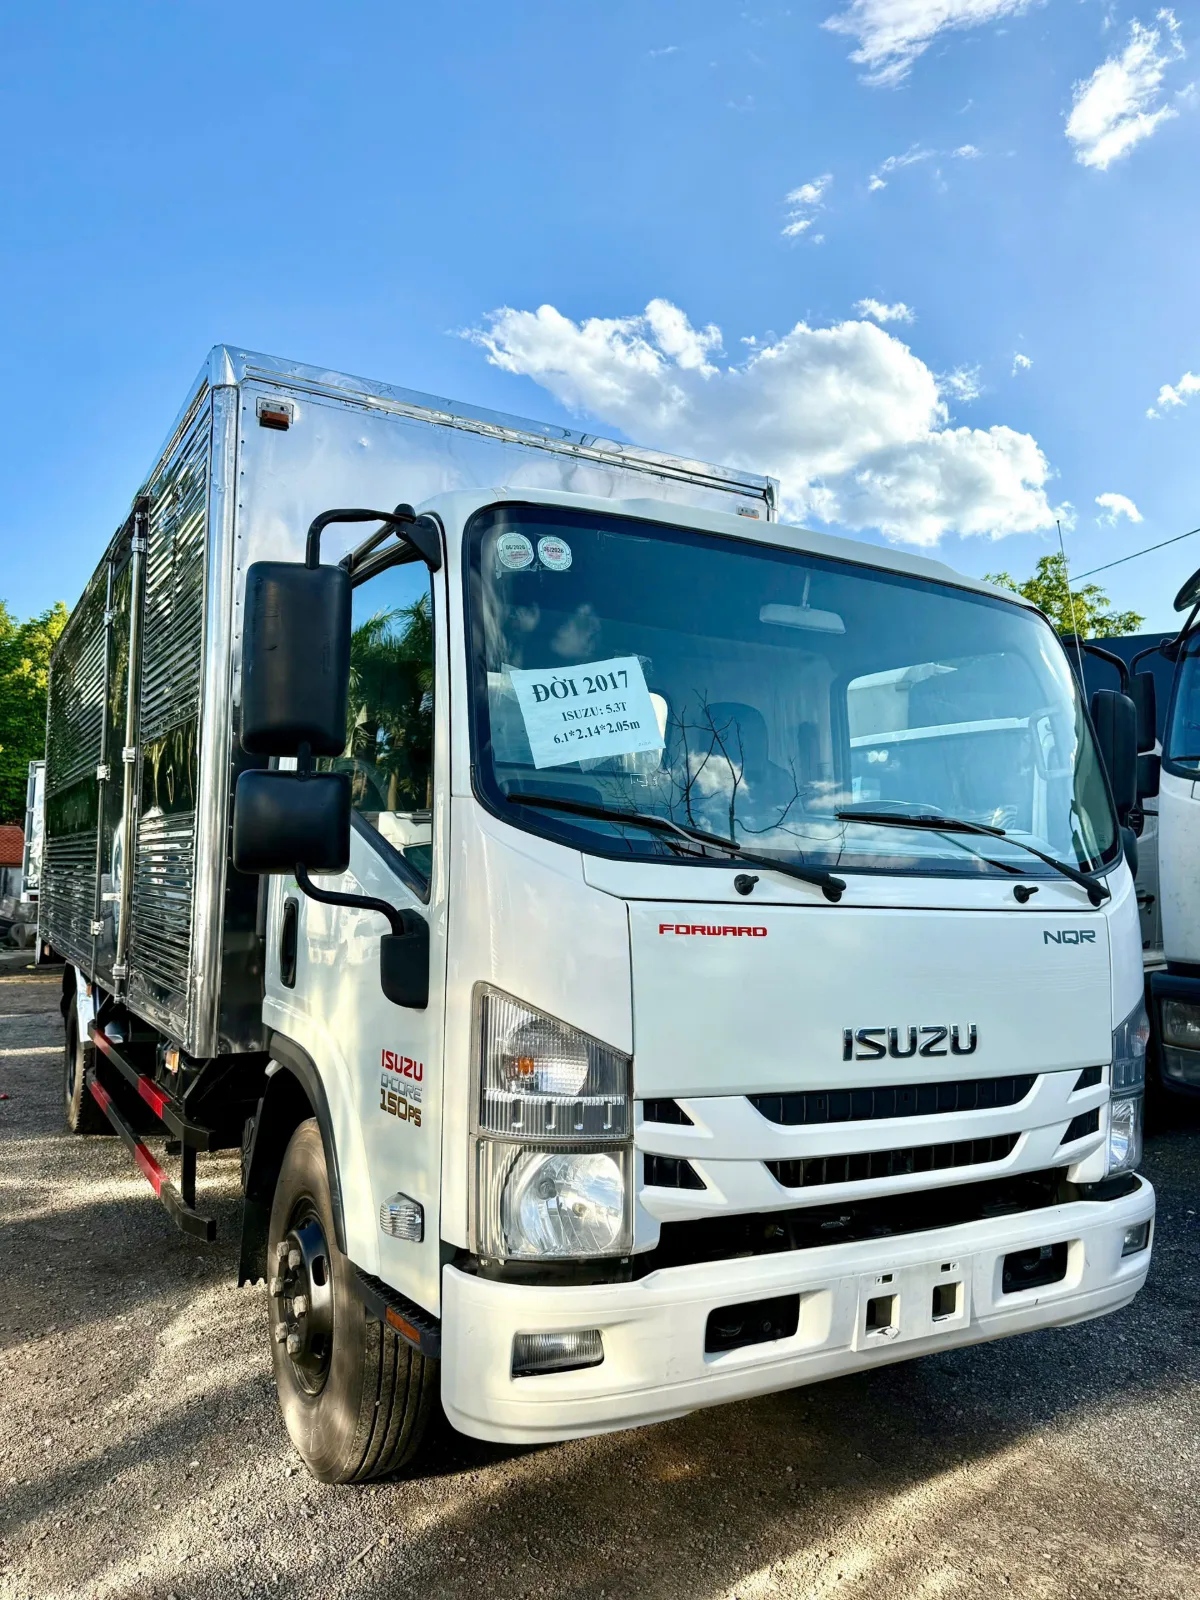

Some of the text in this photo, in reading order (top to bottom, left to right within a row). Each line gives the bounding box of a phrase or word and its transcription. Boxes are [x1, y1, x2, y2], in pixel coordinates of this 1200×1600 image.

[531, 670, 628, 703] ĐỜI 2017
[562, 701, 627, 721] ISUZU: 5.3T
[659, 923, 768, 938] FORWARD
[1043, 929, 1096, 945] NQR
[842, 1022, 978, 1061] ISUZU
[381, 1048, 423, 1082] ISUZU
